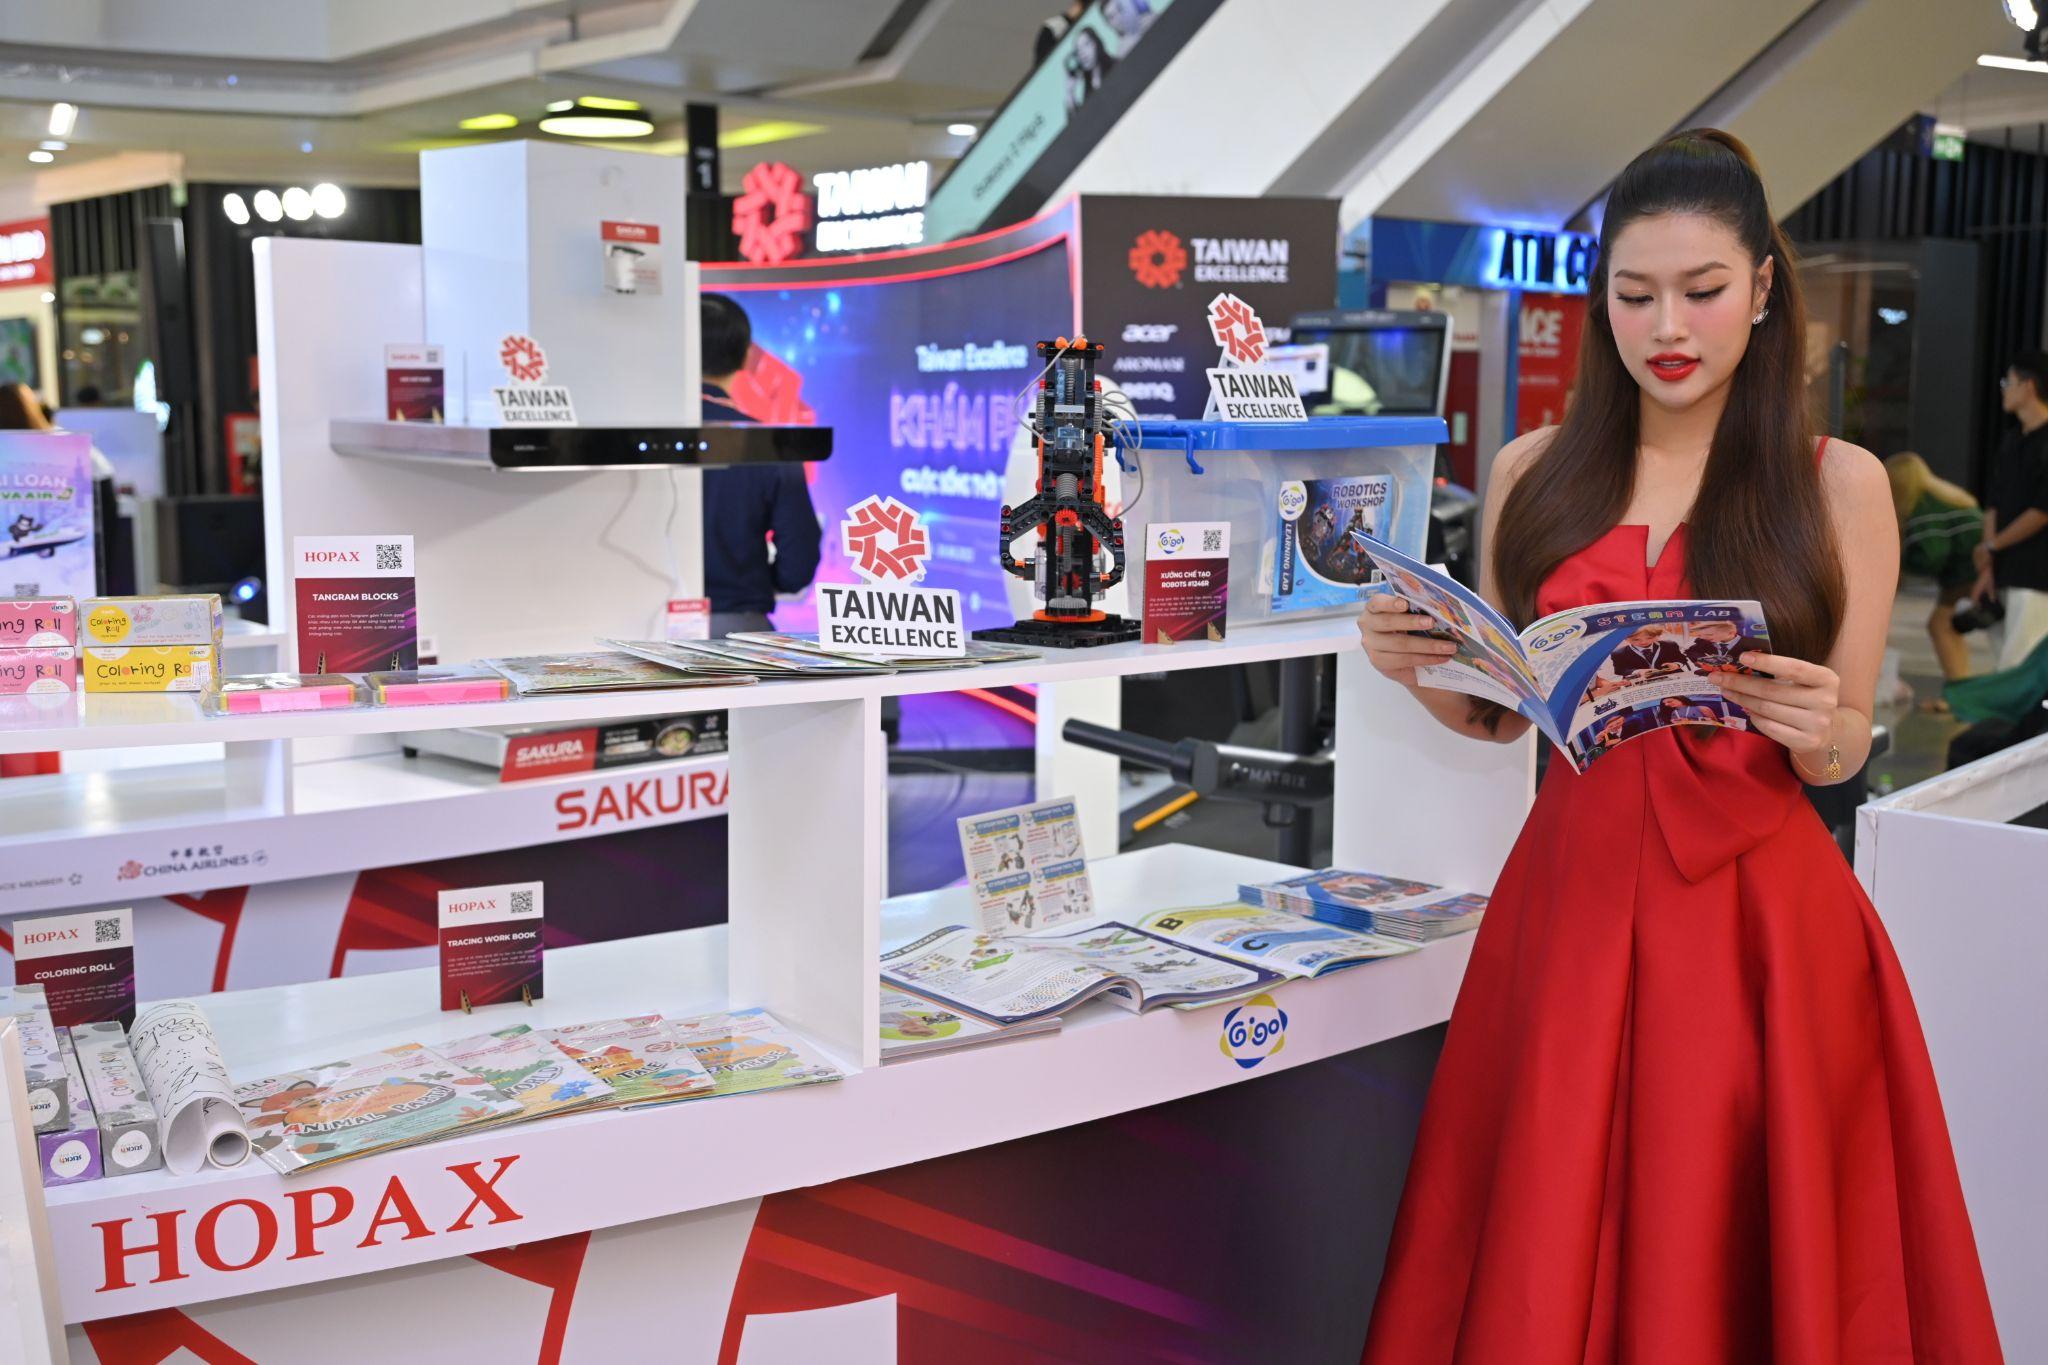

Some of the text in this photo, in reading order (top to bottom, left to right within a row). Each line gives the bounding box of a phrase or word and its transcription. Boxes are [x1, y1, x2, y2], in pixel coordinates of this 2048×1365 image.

[1191, 239, 1289, 264] TAIWAN
[1194, 265, 1288, 282] EXCELLENCE
[1122, 324, 1178, 343] acer
[915, 340, 1028, 372] Taiwan Excellence
[1213, 374, 1296, 398] TAIWAN
[494, 389, 569, 407] TAIWAN
[504, 410, 573, 422] EXCELLENCE
[890, 381, 986, 450] KHÁM
[1227, 403, 1303, 418] EXCELLENCE
[14, 474, 68, 489] LOAN
[1333, 482, 1387, 498] ROBOTICS
[1337, 496, 1385, 508] WORKSHOP
[305, 551, 360, 562] HOPAX
[1281, 523, 1293, 591] LEARNING LAB
[313, 593, 399, 601] TANGRAM BLOCKS
[822, 588, 955, 624] TAIWAN
[1693, 607, 1731, 617] LAB
[832, 624, 958, 649] EXCELLENCE
[515, 739, 584, 762] SAKURA
[1250, 768, 1307, 788] MATRIX
[144, 855, 249, 876] CHINA AIRLINES
[449, 900, 497, 913] HOPAX
[24, 928, 79, 945] HOPAX
[447, 931, 536, 947] TRACING WORK BOOK
[34, 962, 116, 980] COLORING ROLL
[1228, 1017, 1280, 1047] Gigo
[283, 1112, 387, 1135] ANIMAL
[91, 1155, 524, 1293] HOPAX
